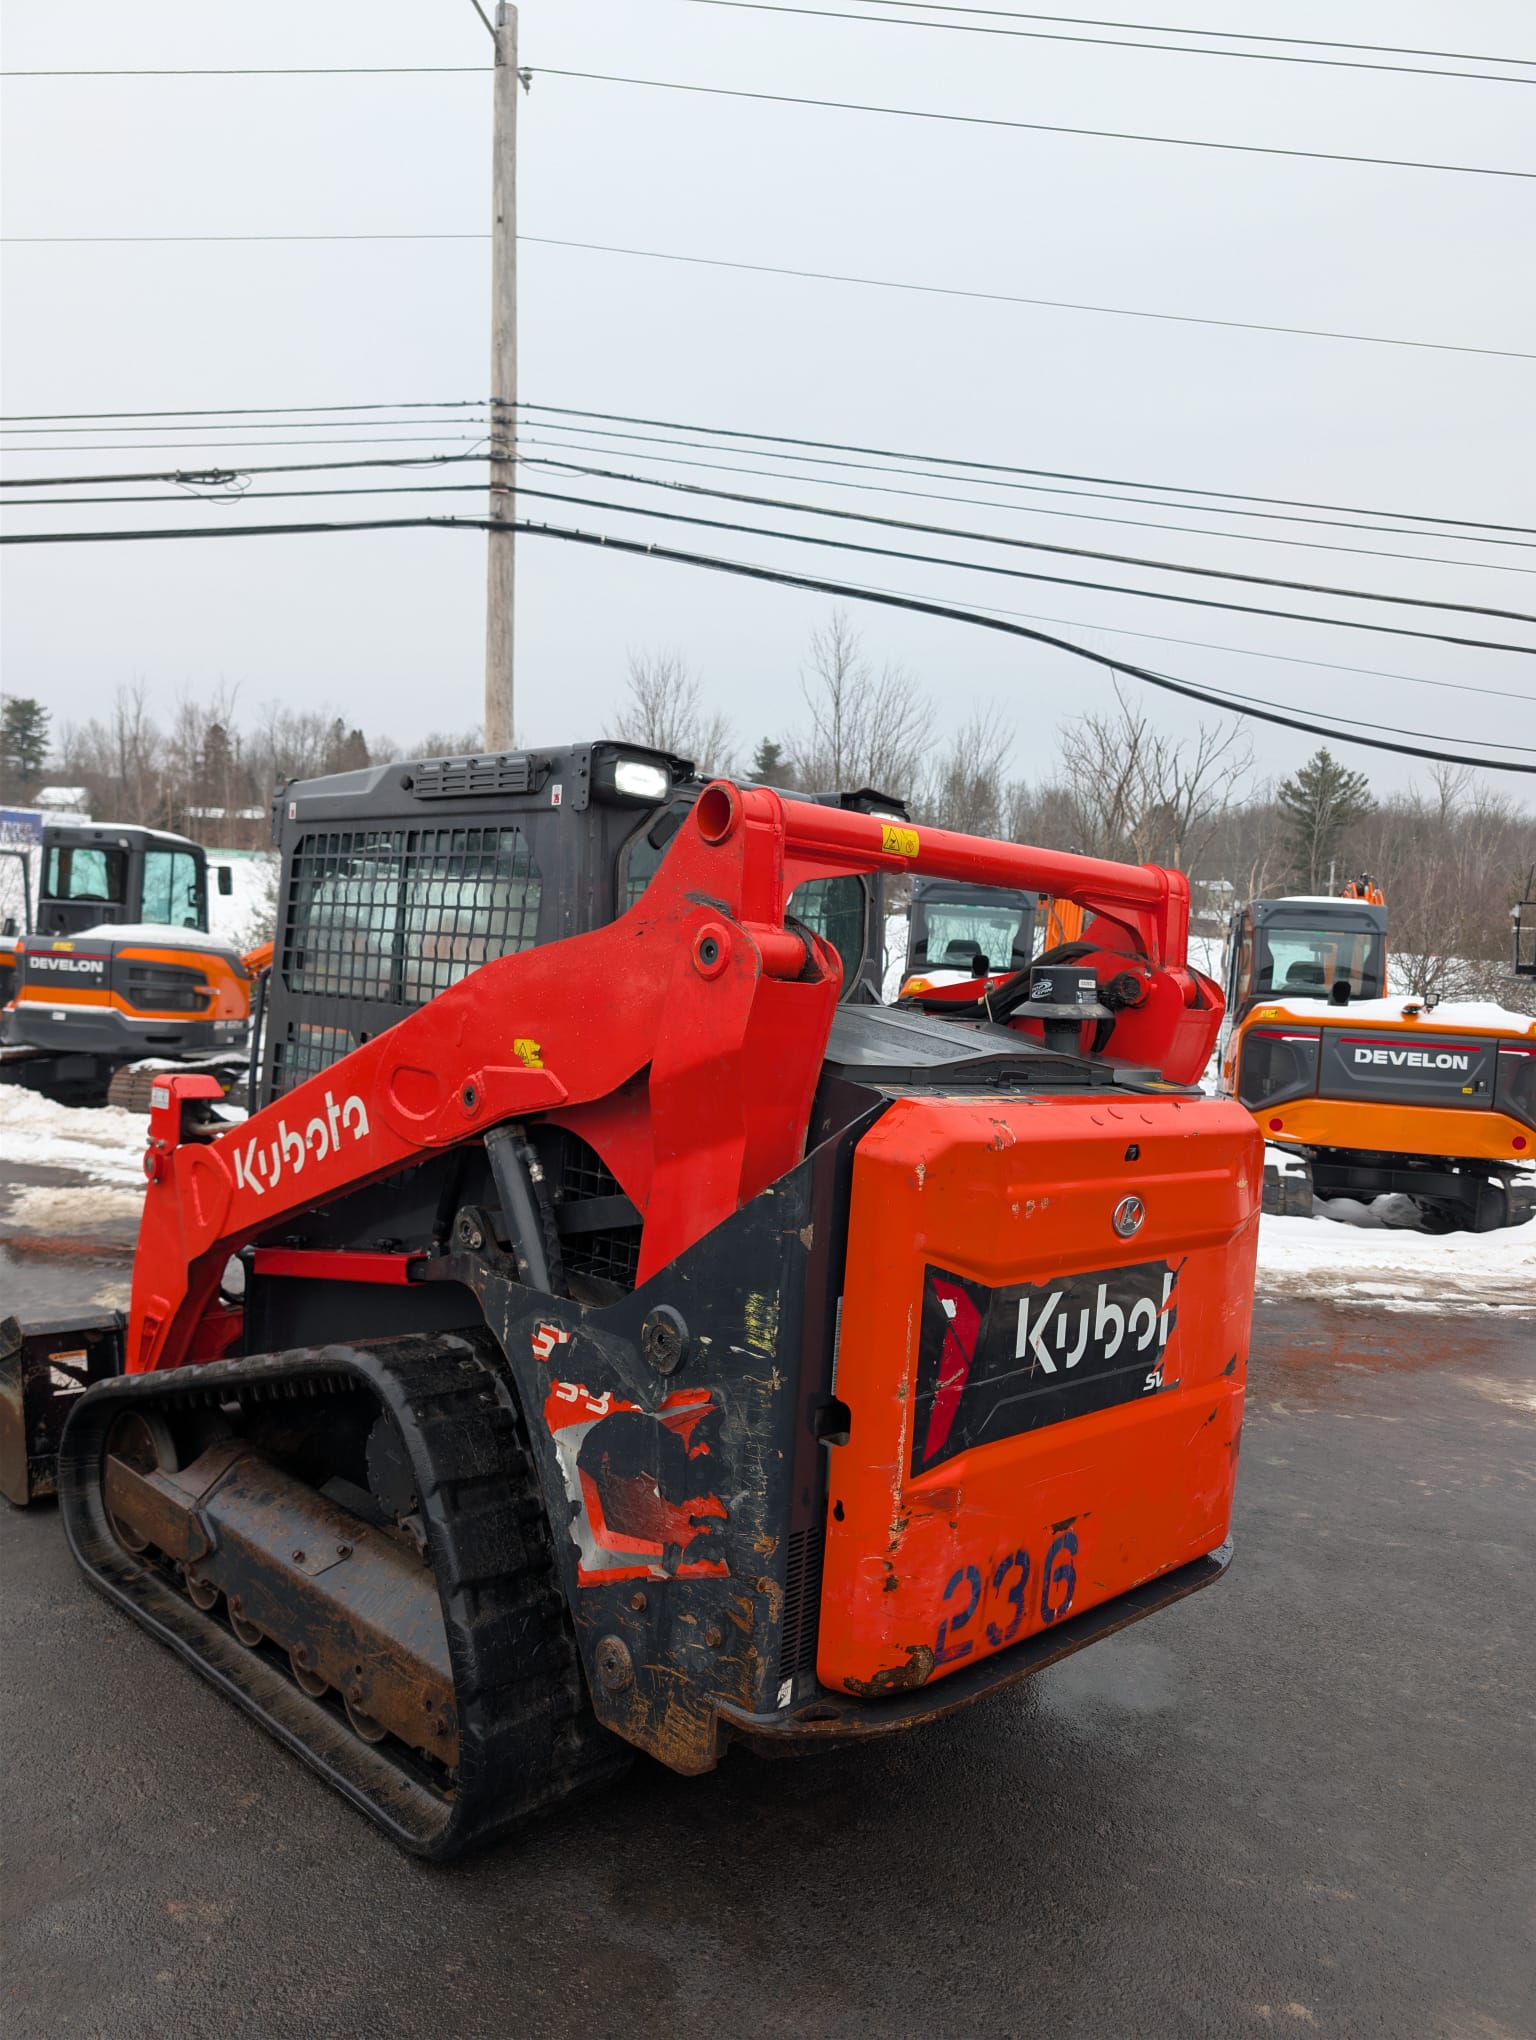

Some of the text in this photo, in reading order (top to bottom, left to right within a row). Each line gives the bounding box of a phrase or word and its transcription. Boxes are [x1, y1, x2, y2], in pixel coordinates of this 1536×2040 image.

[30, 956, 104, 973] DEVELON
[1354, 1048, 1469, 1070] DEVELON
[233, 1090, 370, 1195] Kubota
[934, 1531, 1079, 1667] 236
